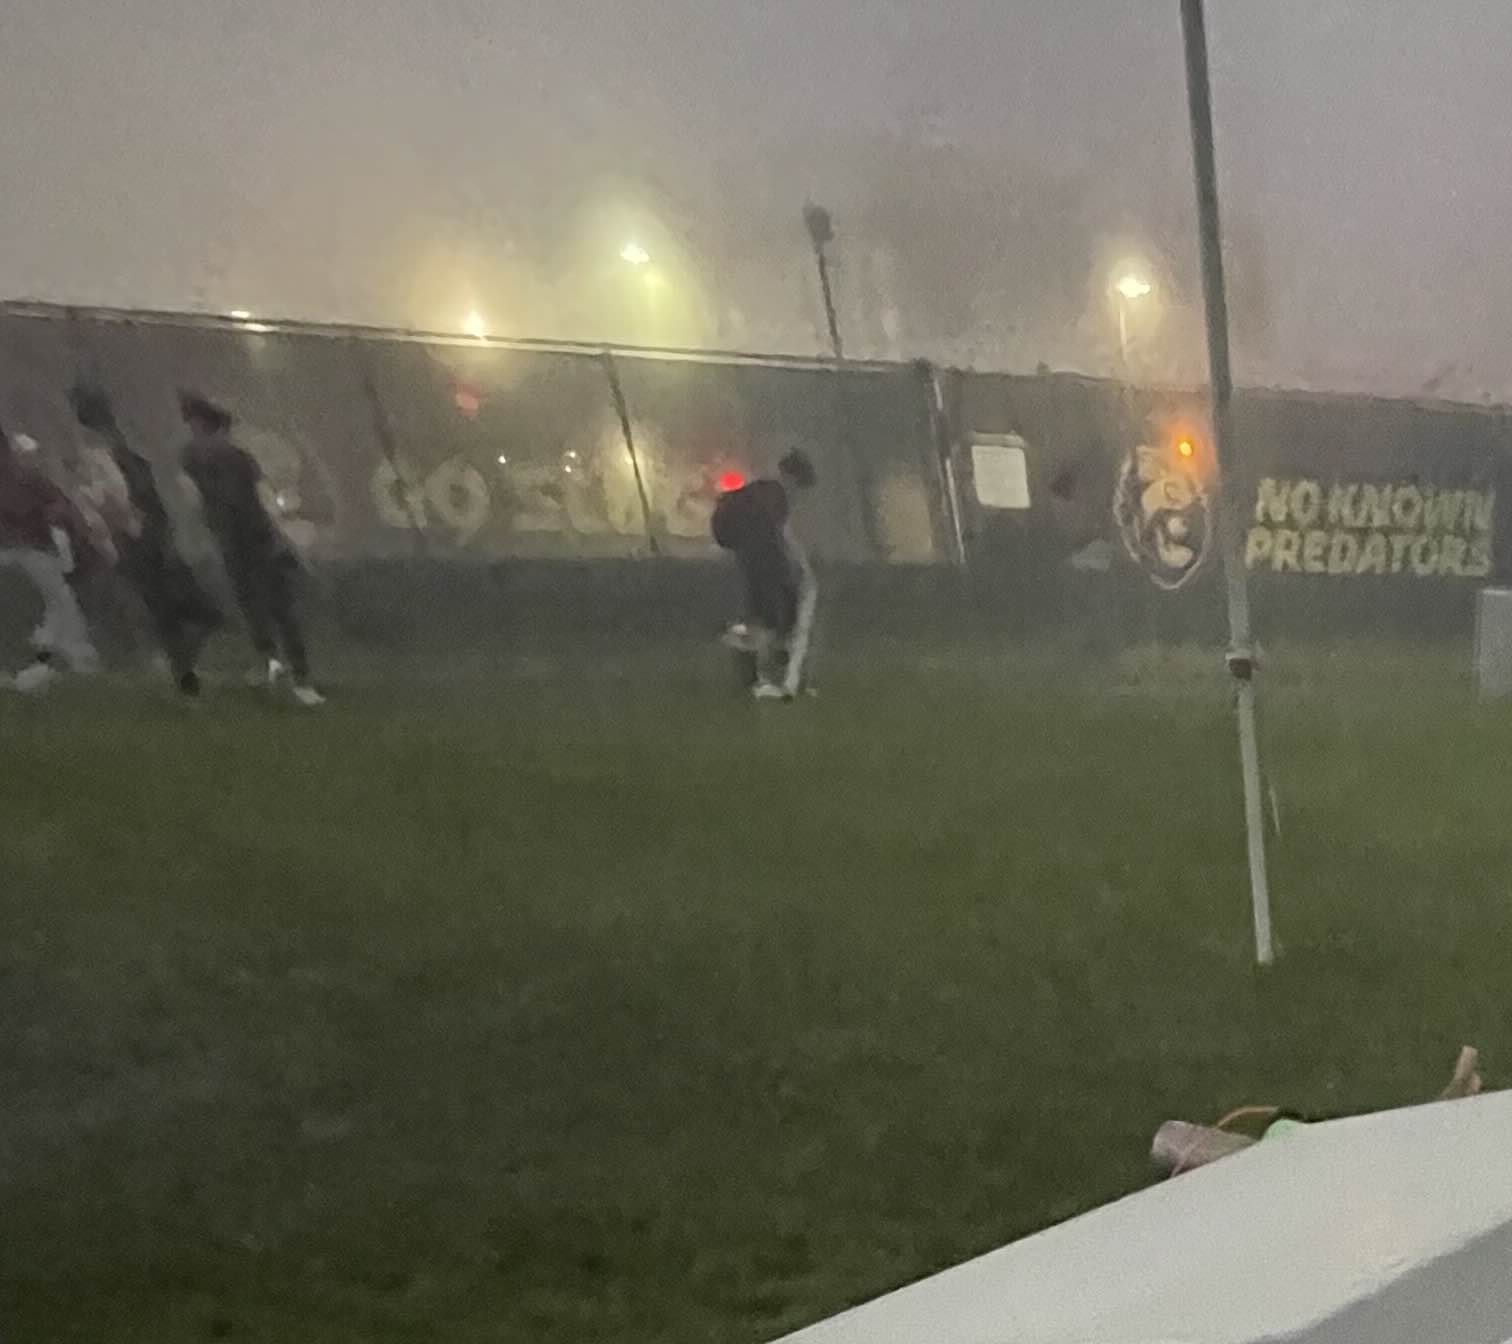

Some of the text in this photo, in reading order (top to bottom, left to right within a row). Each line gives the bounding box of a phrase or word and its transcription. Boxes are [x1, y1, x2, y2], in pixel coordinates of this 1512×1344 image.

[1255, 477, 1494, 531] NO KNOWN
[1245, 527, 1491, 577] PREDATORS
